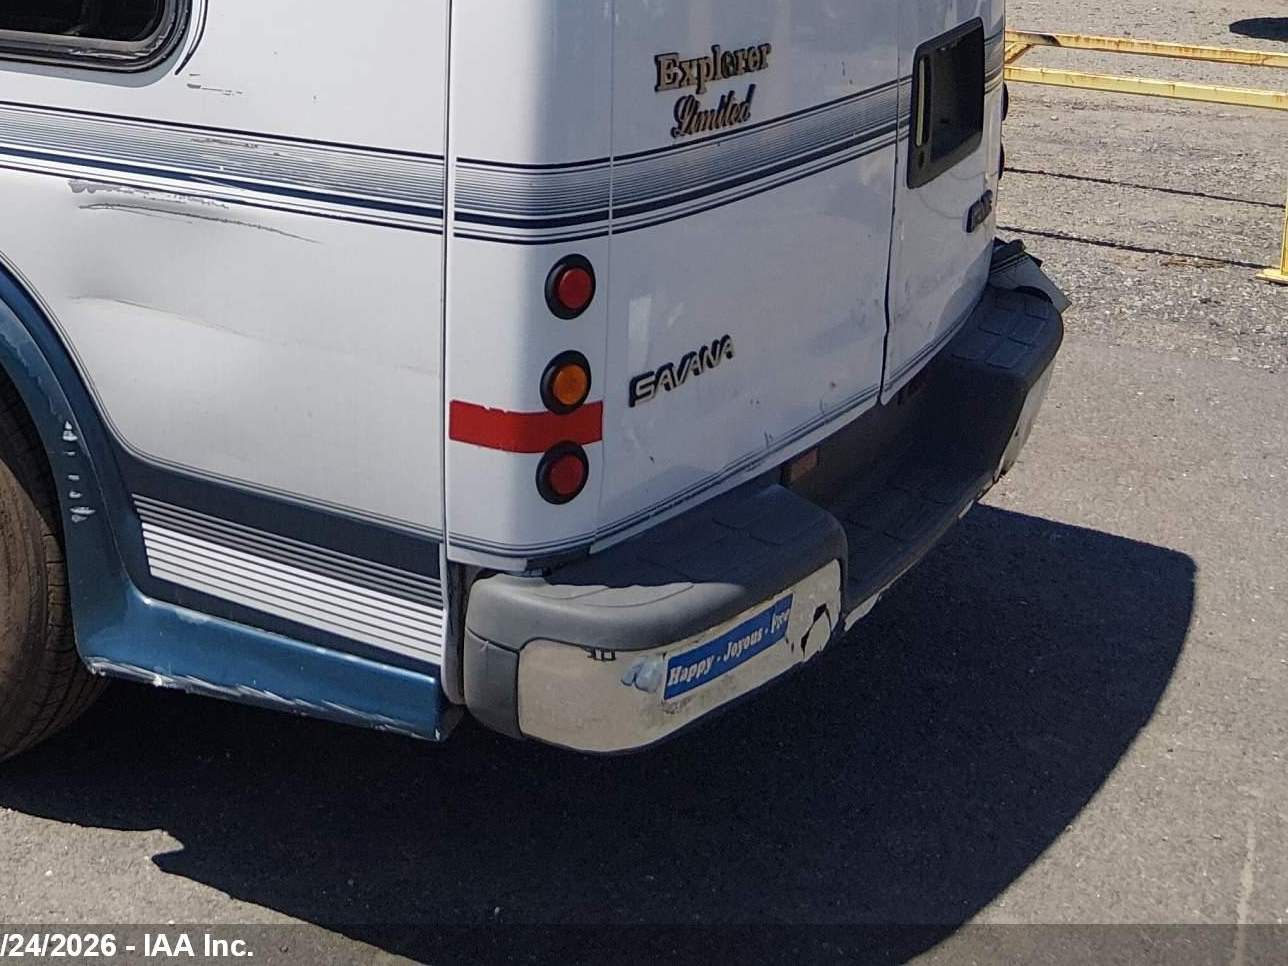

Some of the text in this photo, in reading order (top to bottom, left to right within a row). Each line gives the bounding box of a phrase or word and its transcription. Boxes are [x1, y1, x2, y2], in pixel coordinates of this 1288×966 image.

[654, 42, 772, 95] Explorer
[670, 83, 757, 139] Limited
[628, 333, 736, 409] SAVANA
[667, 653, 716, 687] Happy
[723, 626, 764, 663] Joyous
